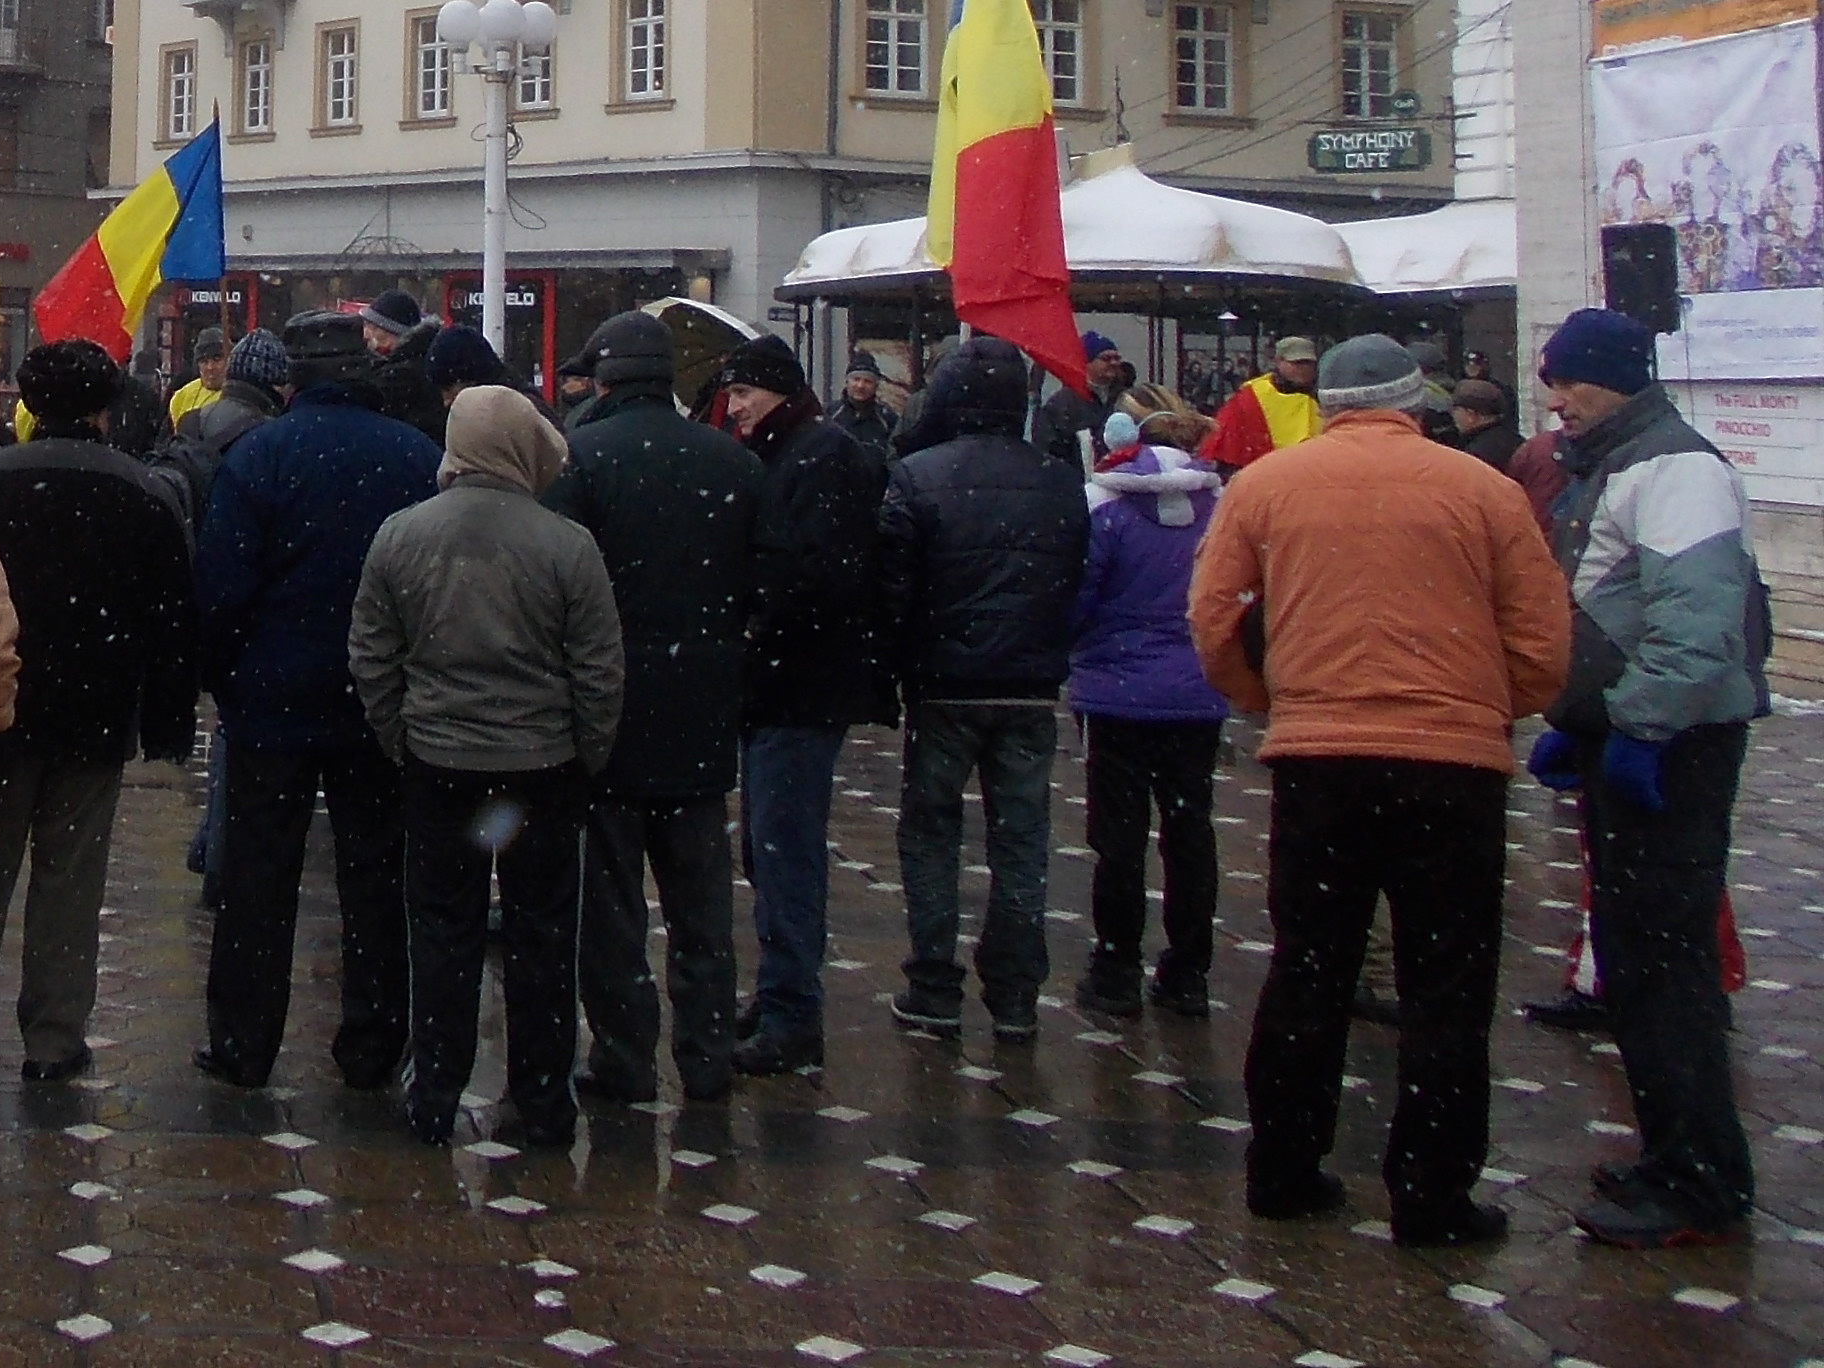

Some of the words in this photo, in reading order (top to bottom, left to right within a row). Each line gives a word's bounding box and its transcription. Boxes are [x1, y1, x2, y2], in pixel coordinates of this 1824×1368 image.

[1316, 131, 1415, 151] SYMPHONY
[192, 291, 241, 303] KENVLO
[469, 292, 535, 306] KEELO
[1732, 394, 1757, 408] FULL
[1760, 395, 1799, 409] MONTY
[1715, 420, 1771, 437] PINOCCHIO
